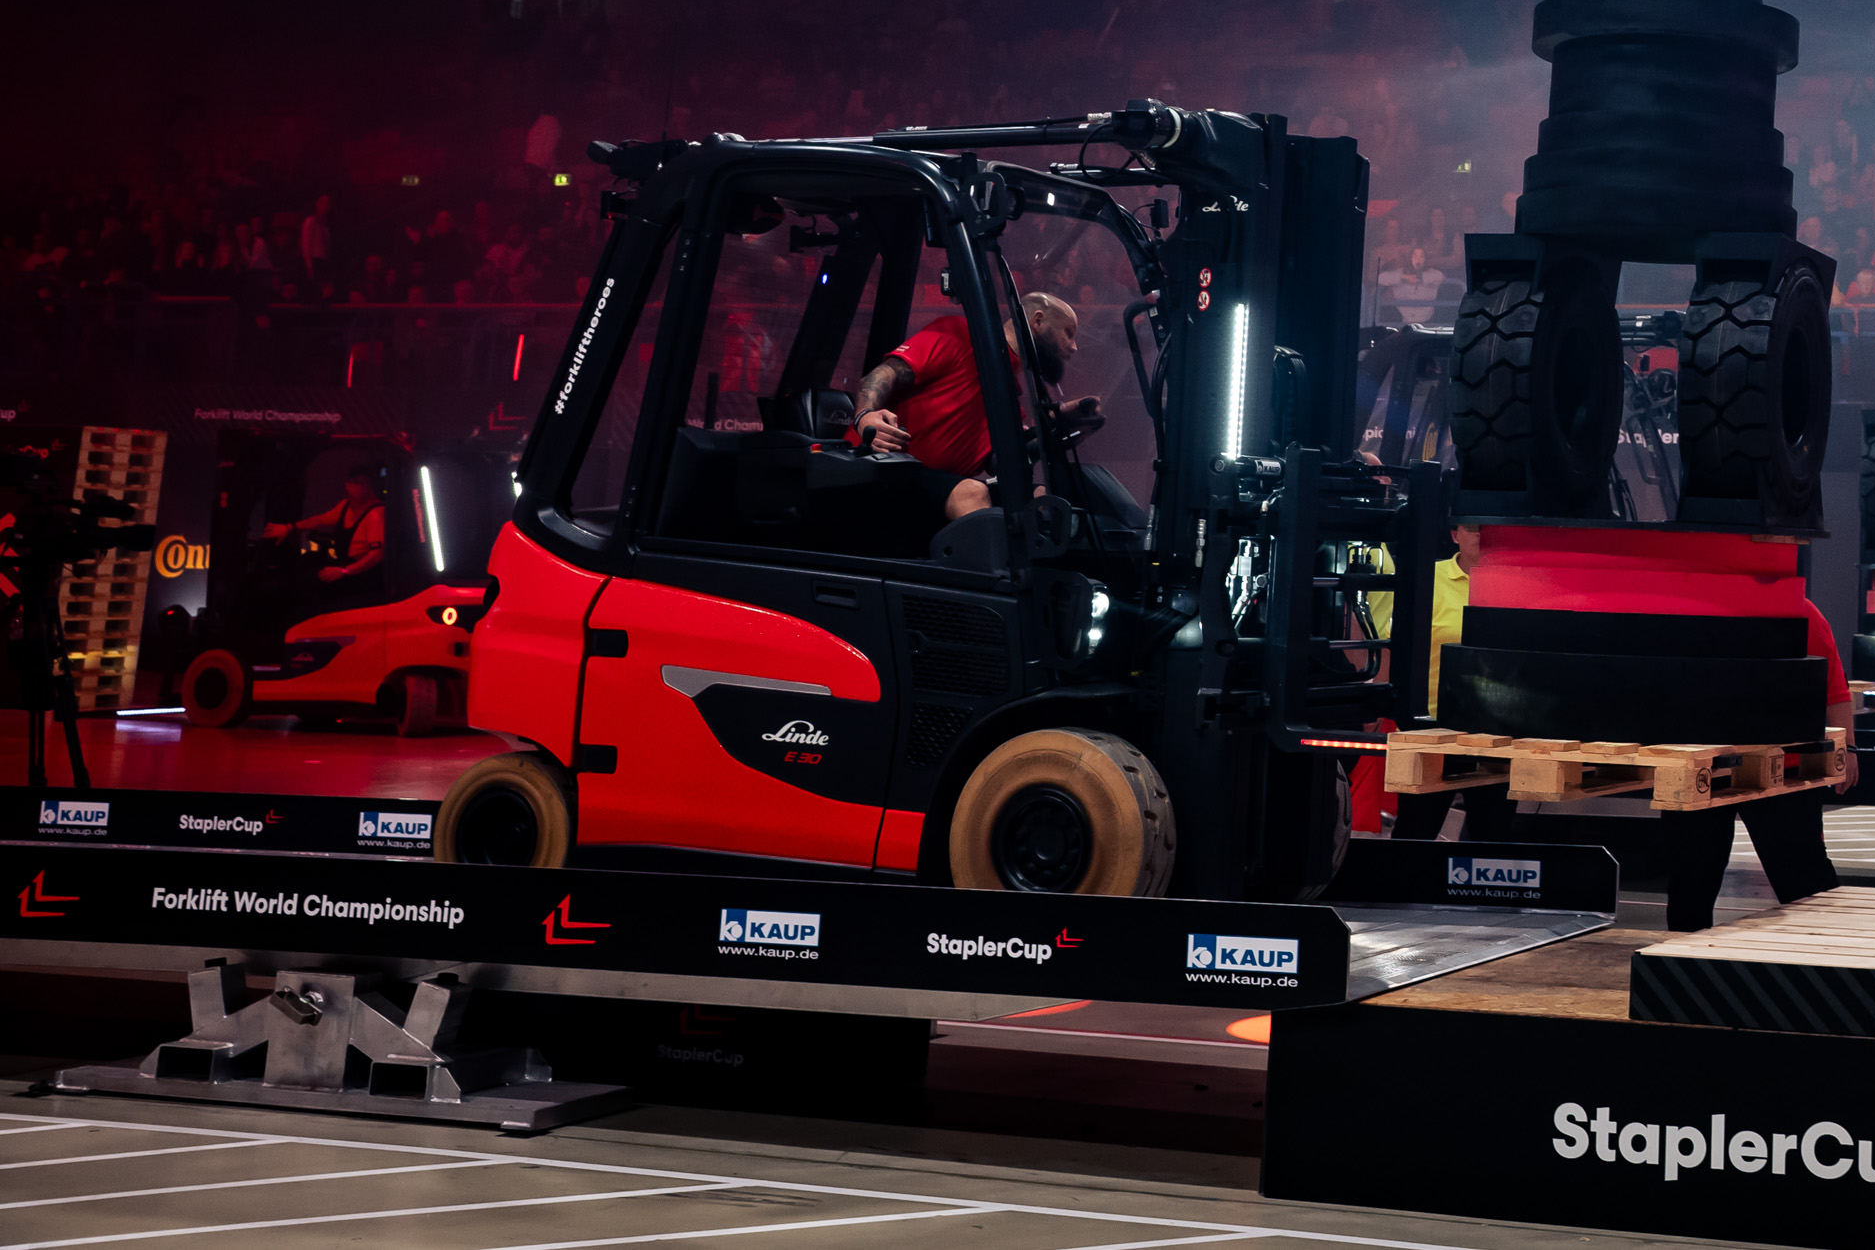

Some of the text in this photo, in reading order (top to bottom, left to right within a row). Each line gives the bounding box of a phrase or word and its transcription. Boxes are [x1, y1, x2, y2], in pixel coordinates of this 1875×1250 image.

[554, 277, 616, 415] #forkliftheroes
[761, 719, 830, 746] Linde
[60, 810, 107, 823] KAUP
[178, 813, 264, 836] StaplerCup
[380, 821, 429, 835] KAUP
[356, 838, 432, 850] www.kaup.de
[1475, 867, 1538, 884] KAUP
[1446, 888, 1542, 900] www.kaup.de
[151, 886, 466, 930] Forklift World Championship
[750, 922, 816, 941] KAUP
[717, 945, 820, 961] www.kaup.de
[926, 932, 1053, 965] StaplerCup
[1220, 947, 1294, 968] KAUP
[1185, 972, 1299, 989] www.kaup.de
[656, 1042, 745, 1068] StaplerCup
